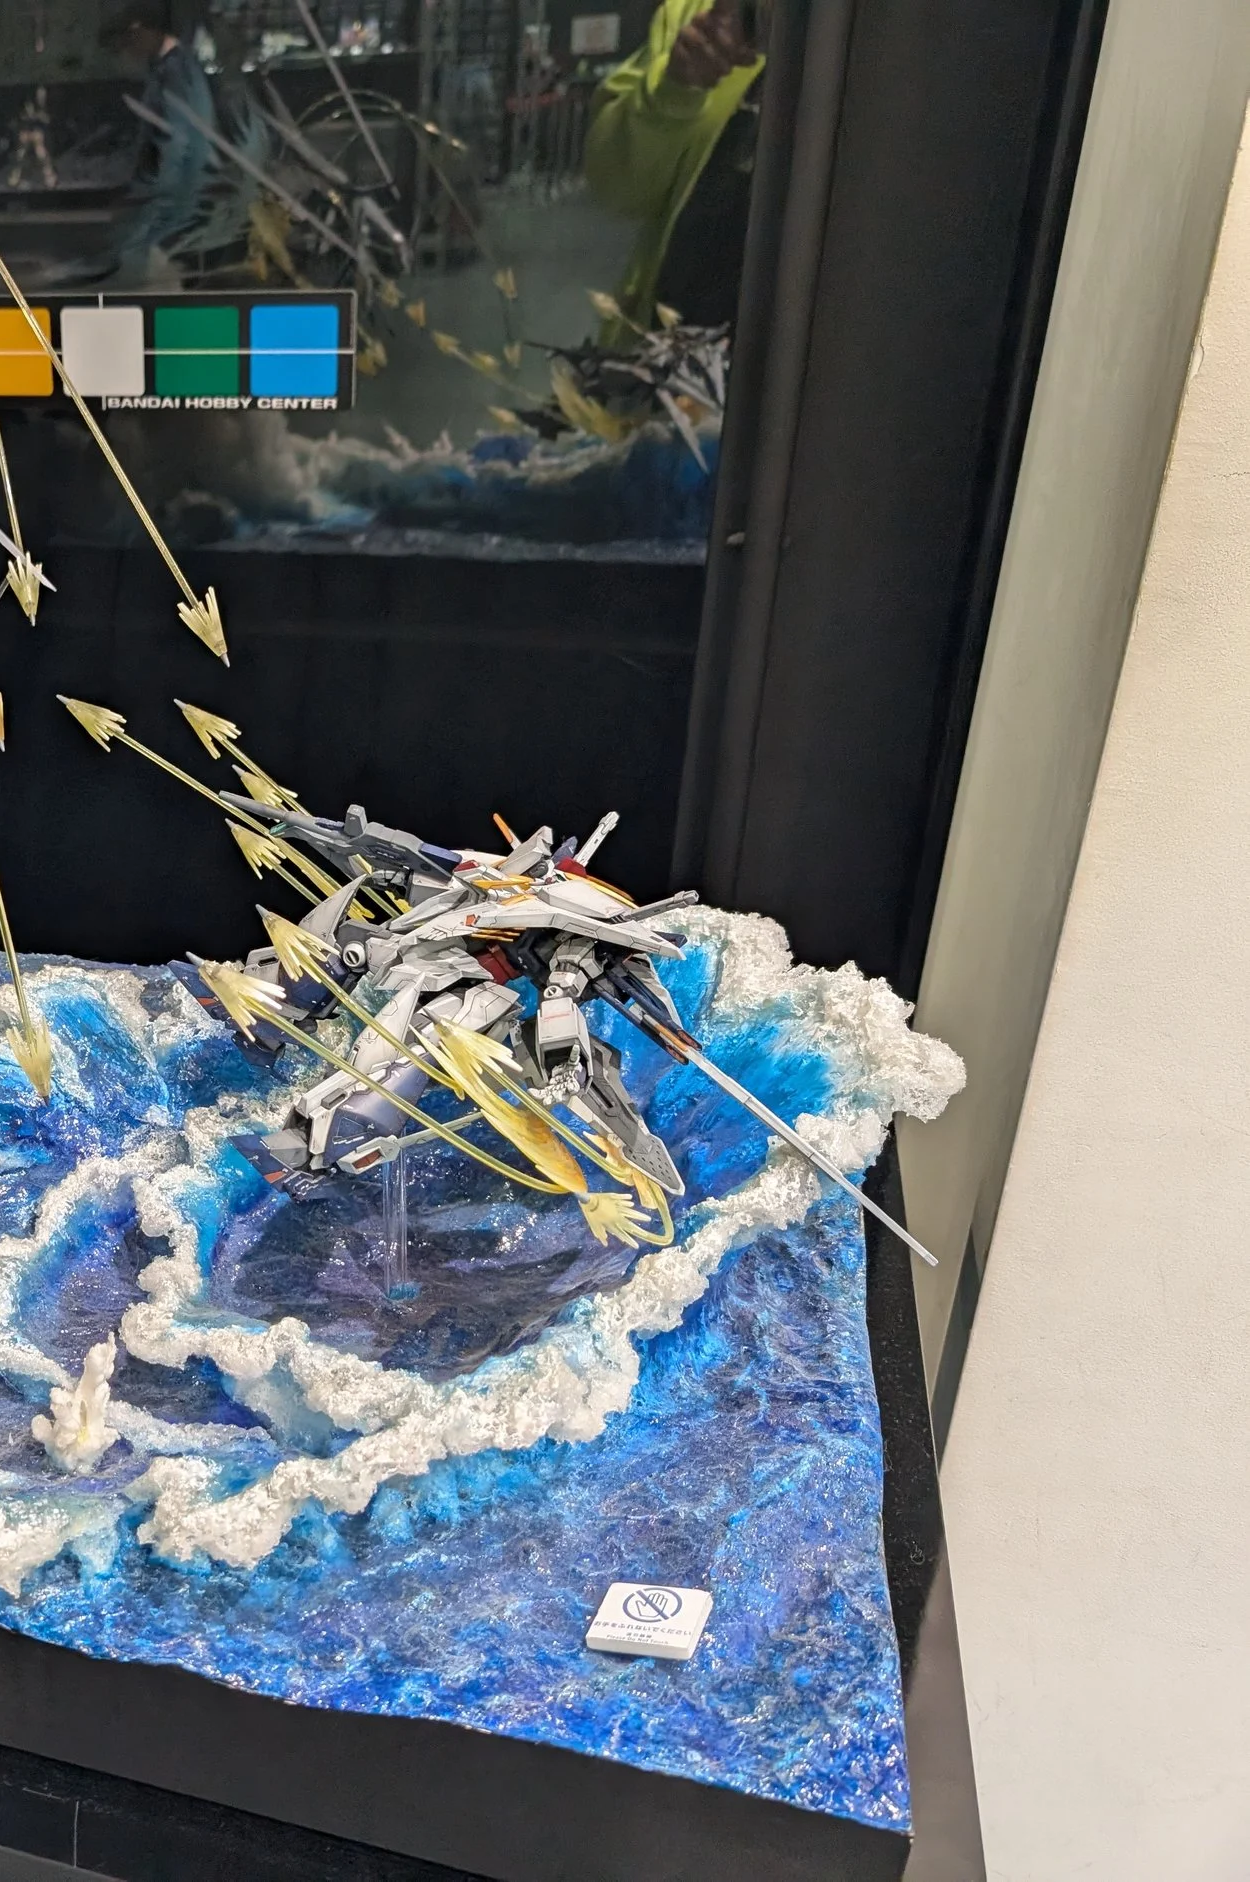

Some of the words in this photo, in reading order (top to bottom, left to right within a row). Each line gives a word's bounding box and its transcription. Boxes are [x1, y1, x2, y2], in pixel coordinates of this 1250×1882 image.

[107, 397, 180, 410] BANDAI
[185, 397, 252, 410] HOBBY
[257, 397, 338, 411] CENTER
